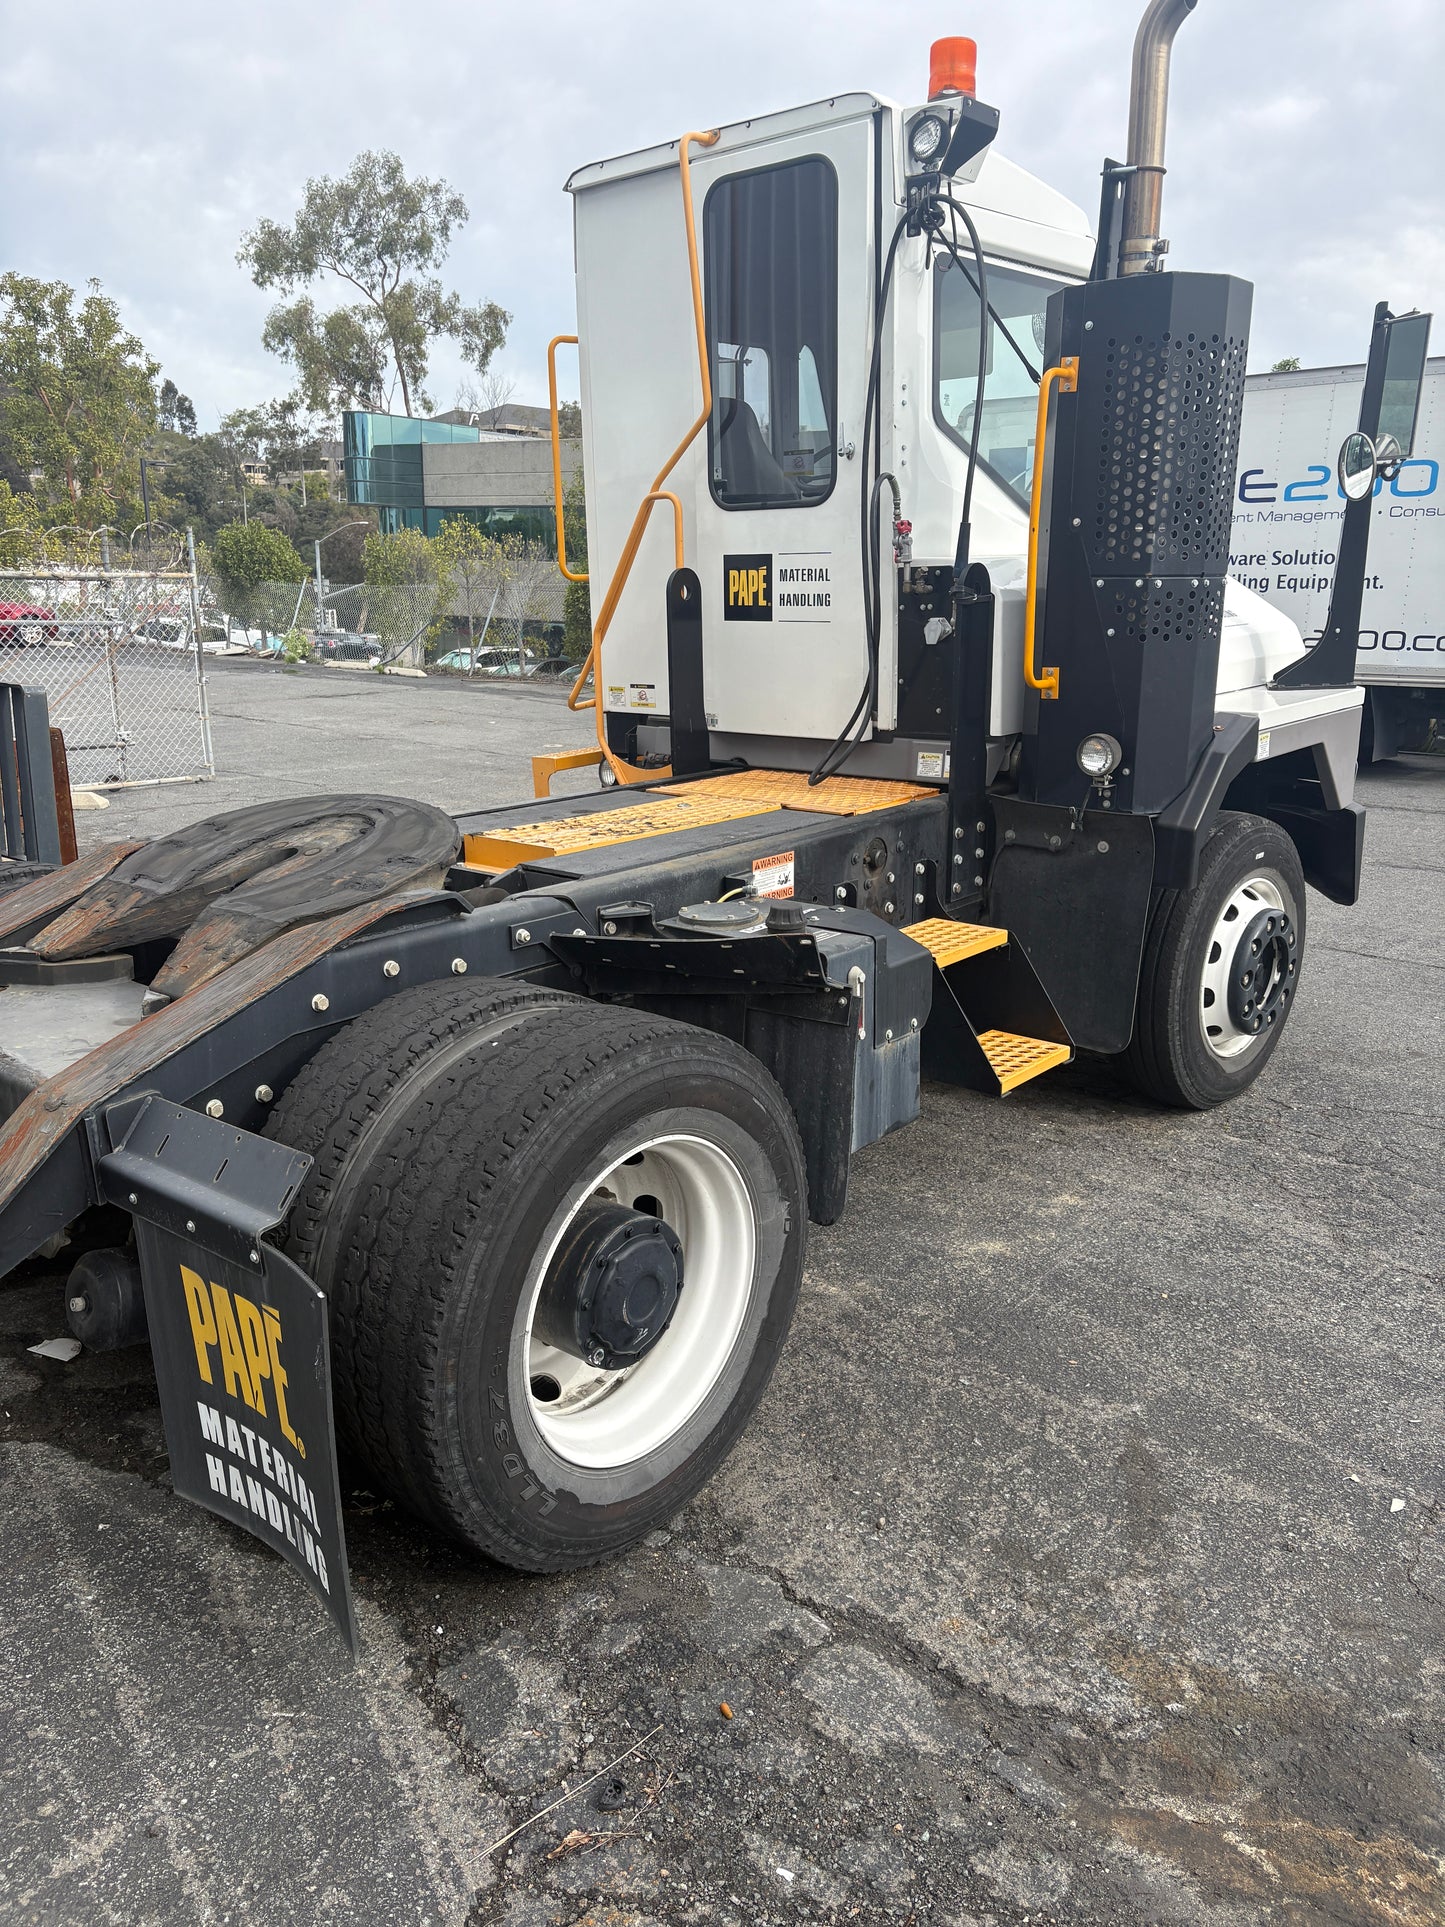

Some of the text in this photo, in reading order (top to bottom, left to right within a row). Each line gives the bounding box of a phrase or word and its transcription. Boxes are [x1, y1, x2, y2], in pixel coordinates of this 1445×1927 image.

[729, 565, 767, 607] PAPÉ
[779, 568, 831, 582] MATERIAL
[779, 593, 831, 607] HANDLING
[761, 853, 793, 869] WARNING
[762, 887, 793, 899] ARNING
[180, 1264, 298, 1450] PAPÉ
[196, 1401, 322, 1538] MATERIAL
[205, 1452, 331, 1596] HANDLING
